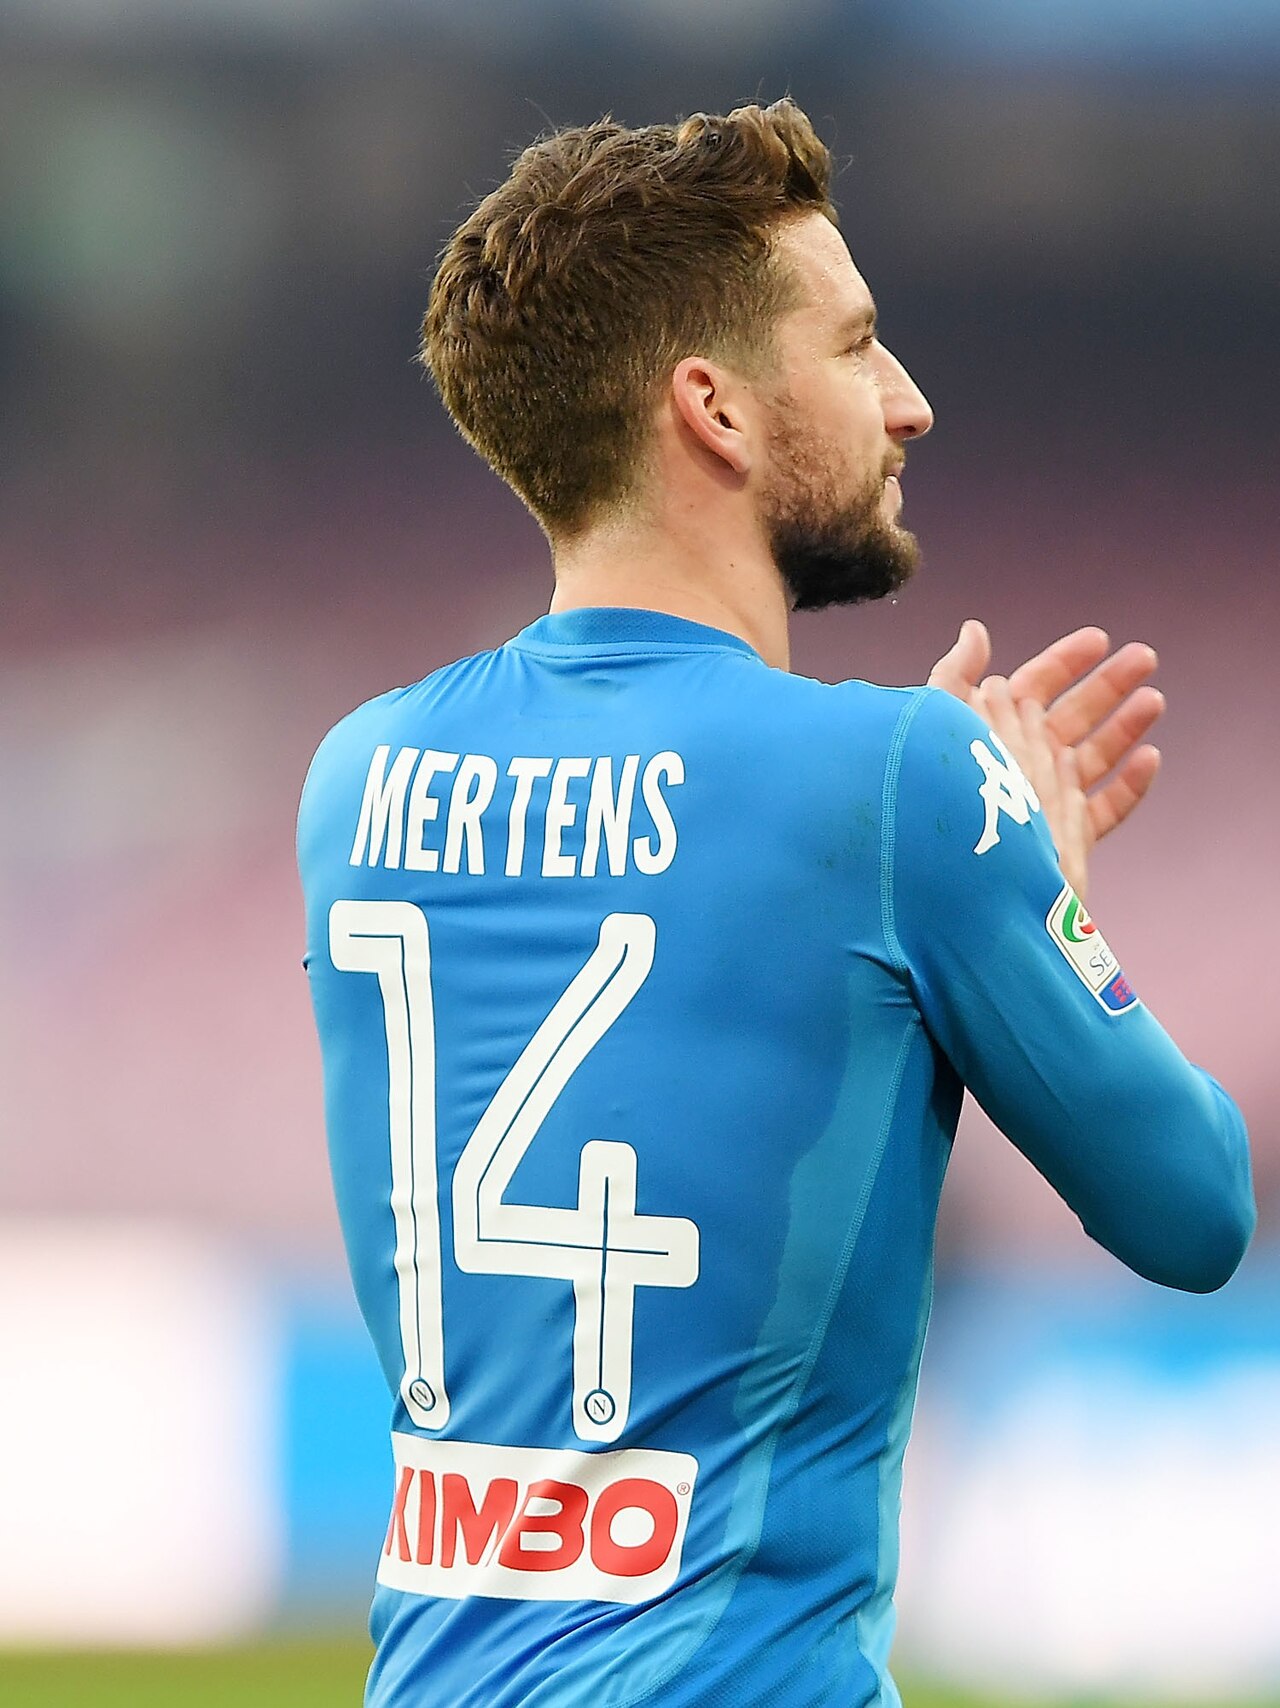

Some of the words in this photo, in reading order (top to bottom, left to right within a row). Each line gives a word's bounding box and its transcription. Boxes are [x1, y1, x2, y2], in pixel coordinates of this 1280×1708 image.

[348, 744, 685, 878] MERTENS
[328, 899, 700, 1443] 14
[385, 1465, 679, 1578] KIMBO
